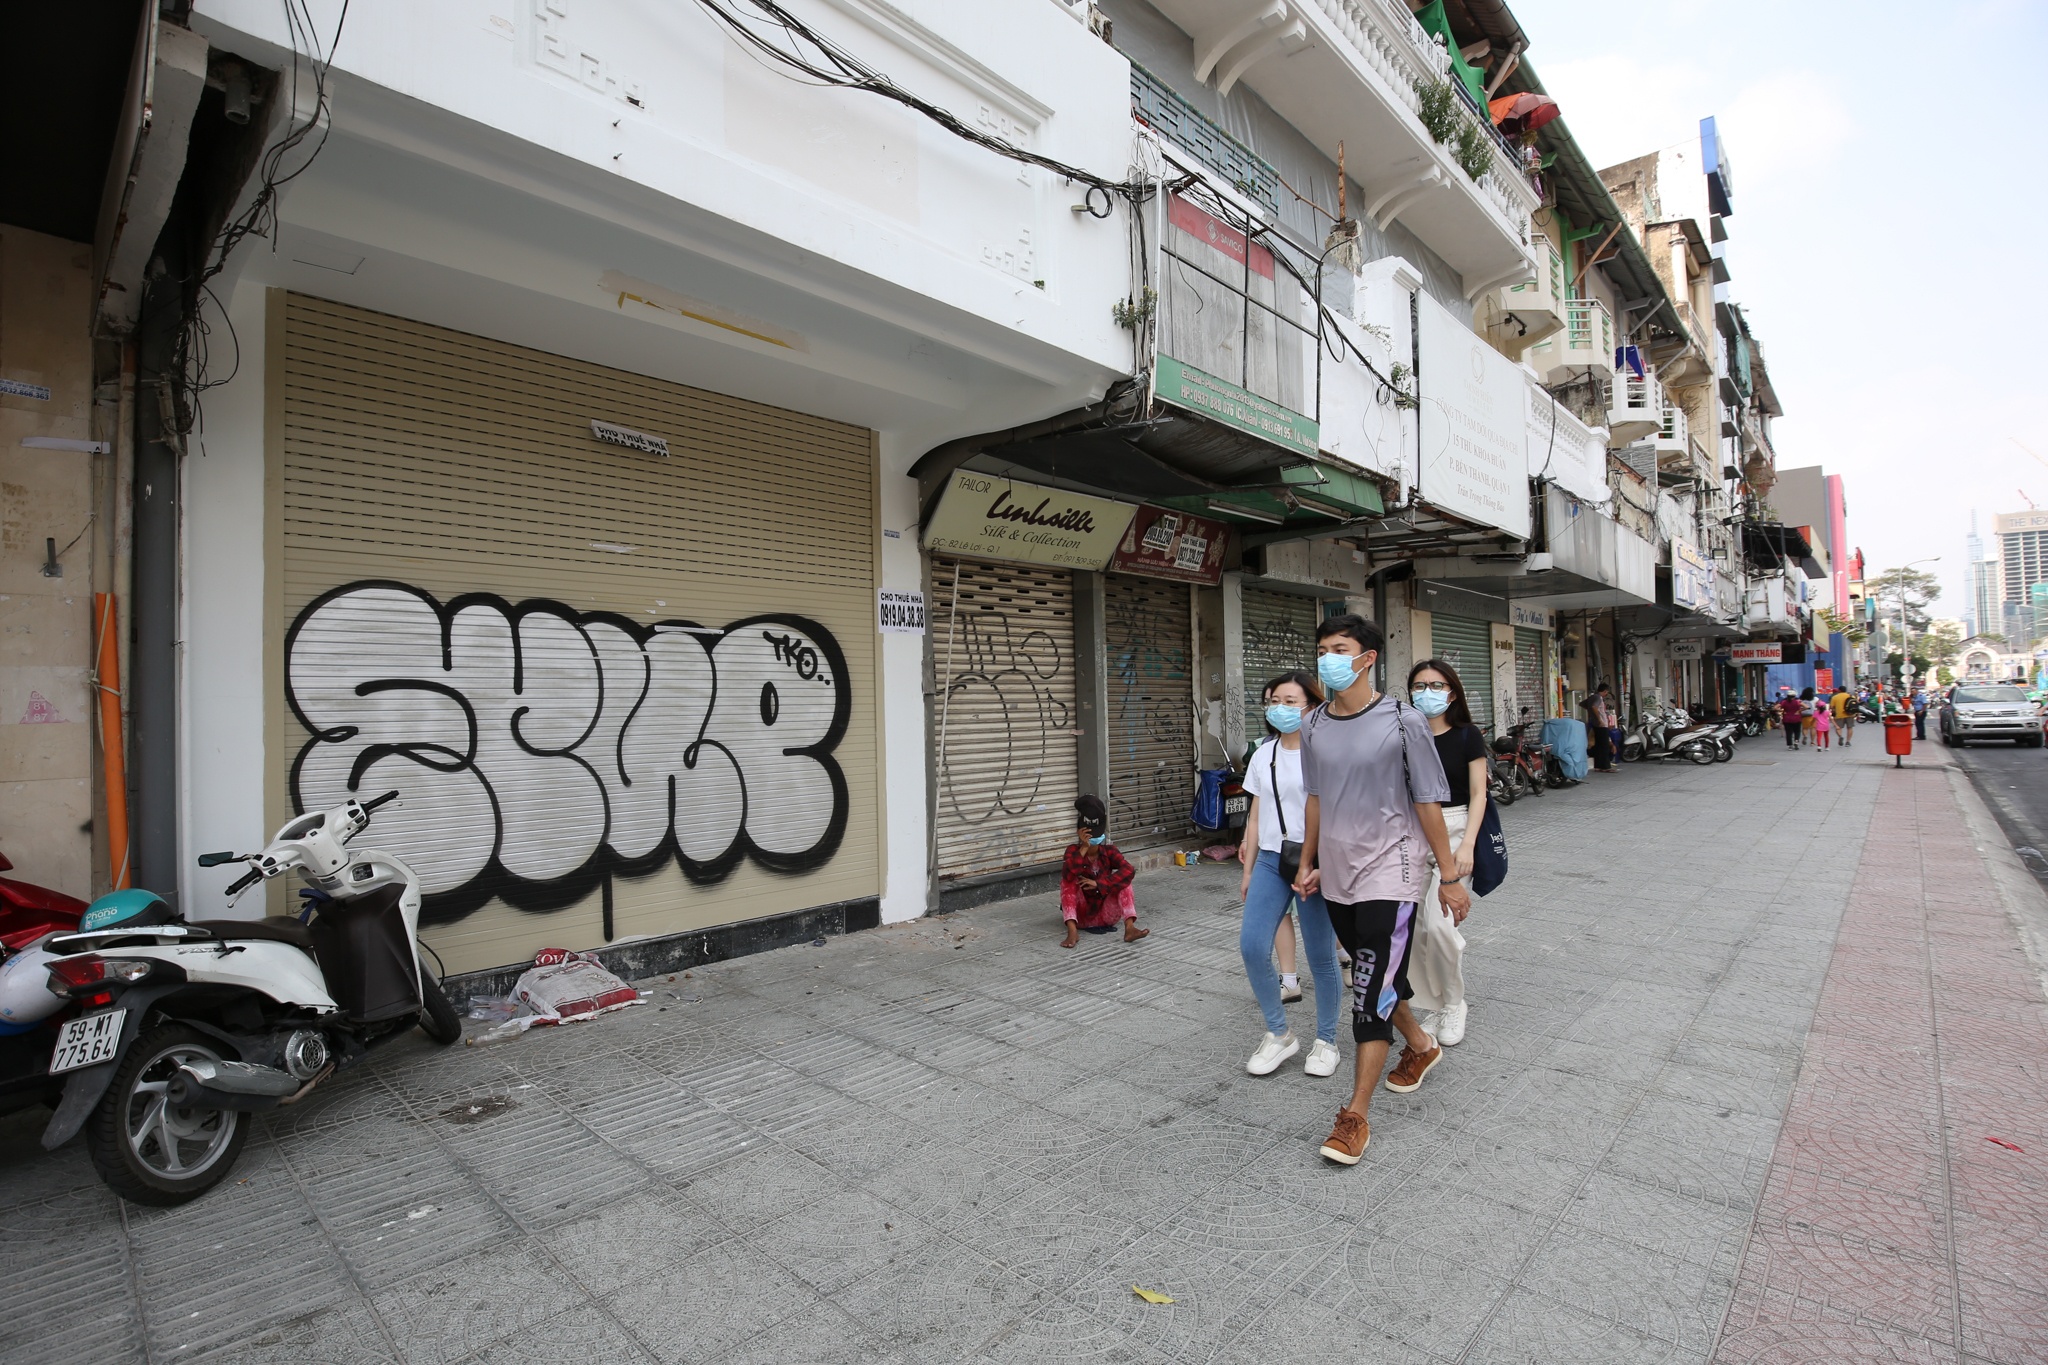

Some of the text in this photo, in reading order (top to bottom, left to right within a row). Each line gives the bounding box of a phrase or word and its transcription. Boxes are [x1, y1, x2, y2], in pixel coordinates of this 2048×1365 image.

[1220, 233, 1244, 254] SAVICO
[1193, 389, 1209, 408] 0937
[1436, 396, 1454, 419] CÔNG
[1454, 408, 1462, 424] TY
[1453, 433, 1460, 447] 15
[1473, 444, 1491, 463] KHOA
[958, 477, 992, 494] TAILOR
[931, 538, 948, 547] ĐC:
[948, 539, 959, 548] 82
[959, 541, 970, 549] Lê
[986, 545, 1001, 554] Q.1
[979, 525, 1082, 550] Silk & Collection
[880, 593, 923, 604] CHO THUÊ NHÀ
[880, 603, 924, 628] 0919.04.38.38
[1732, 649, 1754, 660] MẠNH
[67, 1013, 114, 1045] 59-M1
[54, 1036, 113, 1070] 775.64
